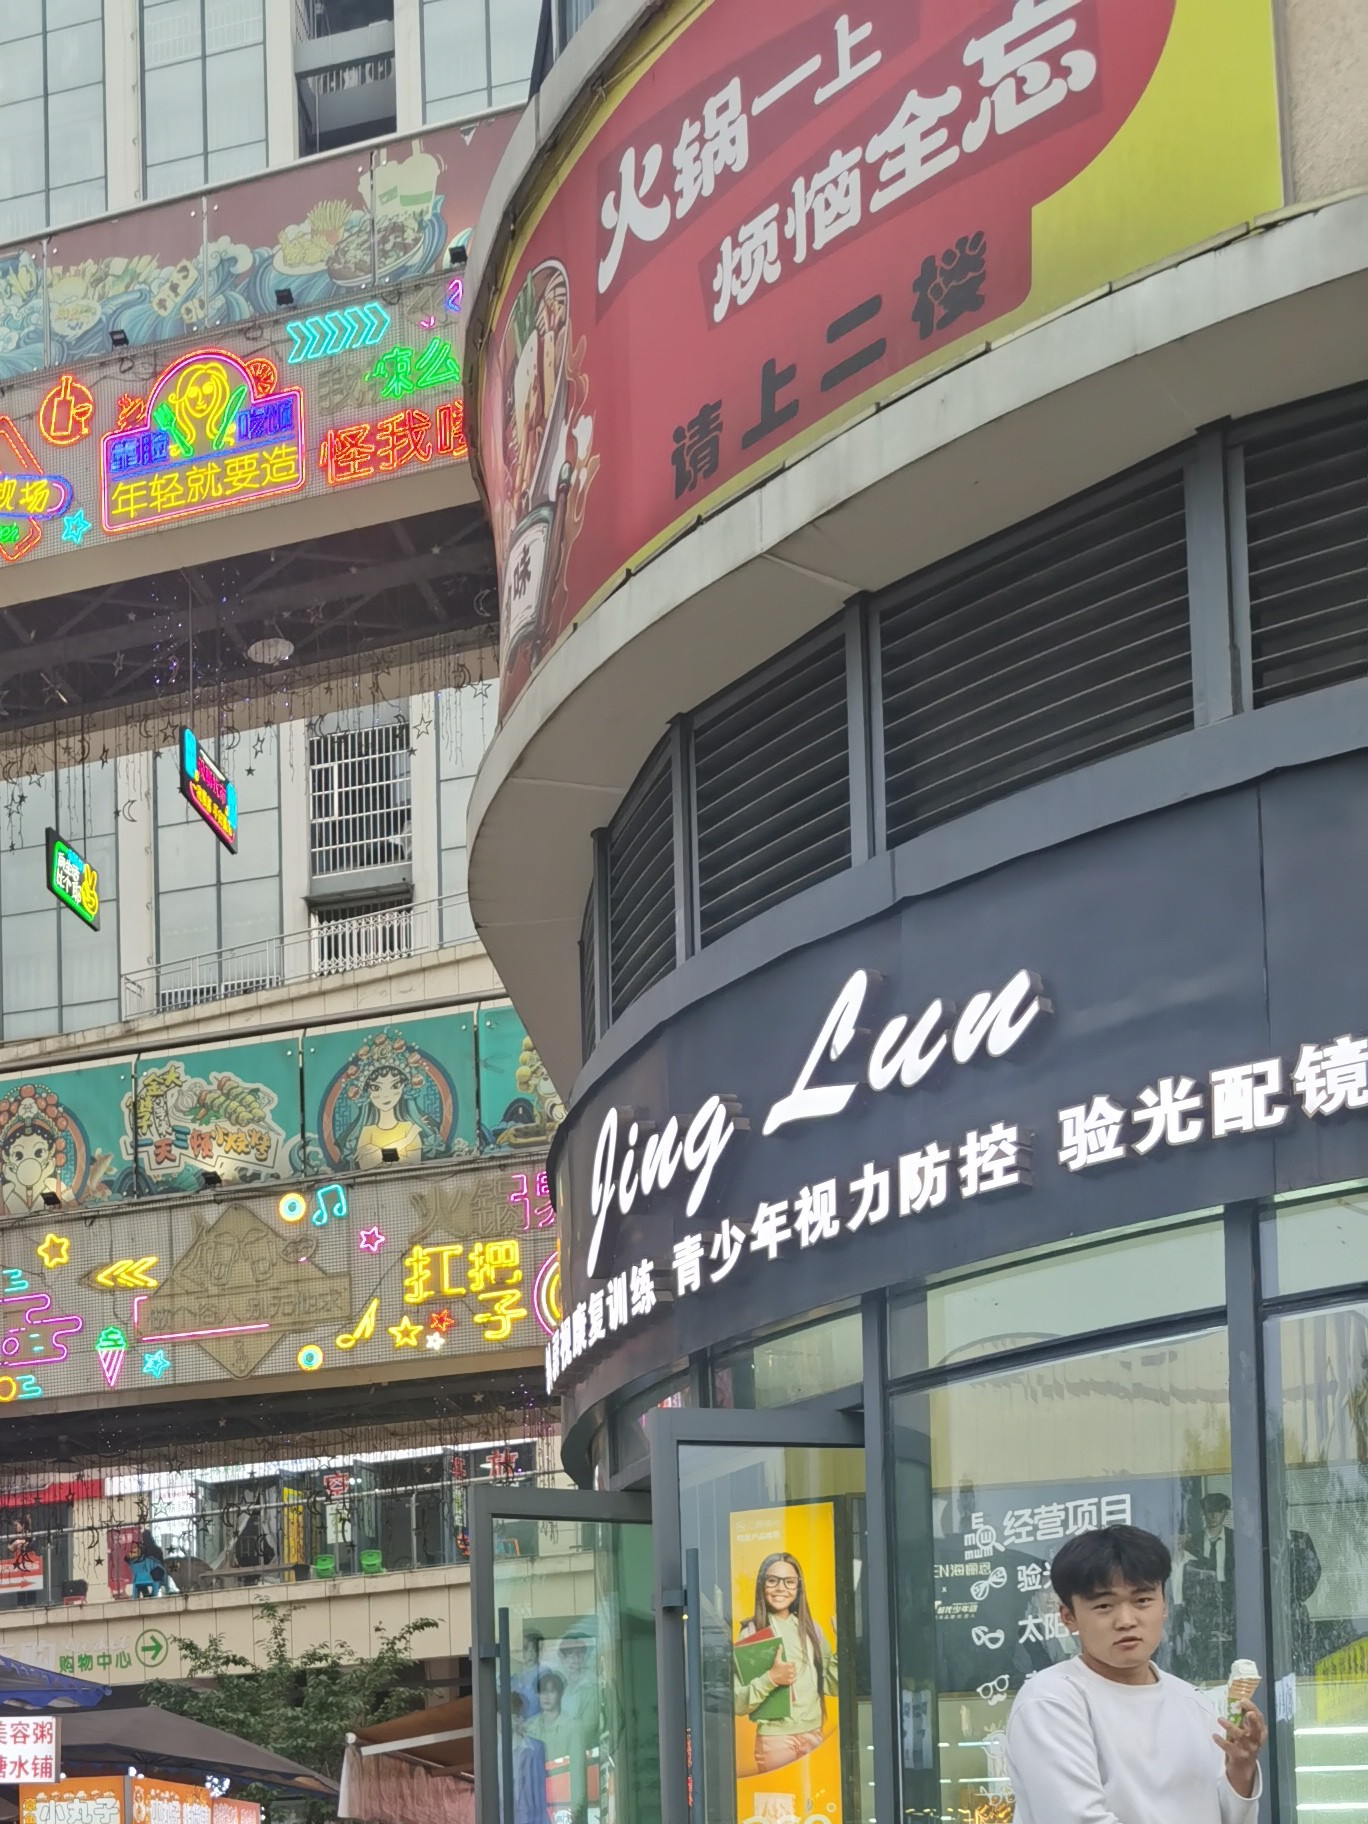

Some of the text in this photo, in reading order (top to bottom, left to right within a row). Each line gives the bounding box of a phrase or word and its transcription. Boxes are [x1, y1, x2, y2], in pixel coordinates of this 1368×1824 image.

[596, 13, 882, 297] 火锅一上
[712, 0, 1098, 322] 烦恼全忘
[111, 443, 299, 518] 年轻就要造
[671, 230, 988, 500] 请上二楼
[586, 967, 1047, 1277] Jing Lun
[672, 1120, 1021, 1299] 青少年视力防控
[1057, 1033, 1368, 1174] 验光配镜
[1003, 1493, 1132, 1545] 经营项目
[1018, 1613, 1079, 1643] 太阳
[59, 1650, 132, 1673] 购物中心
